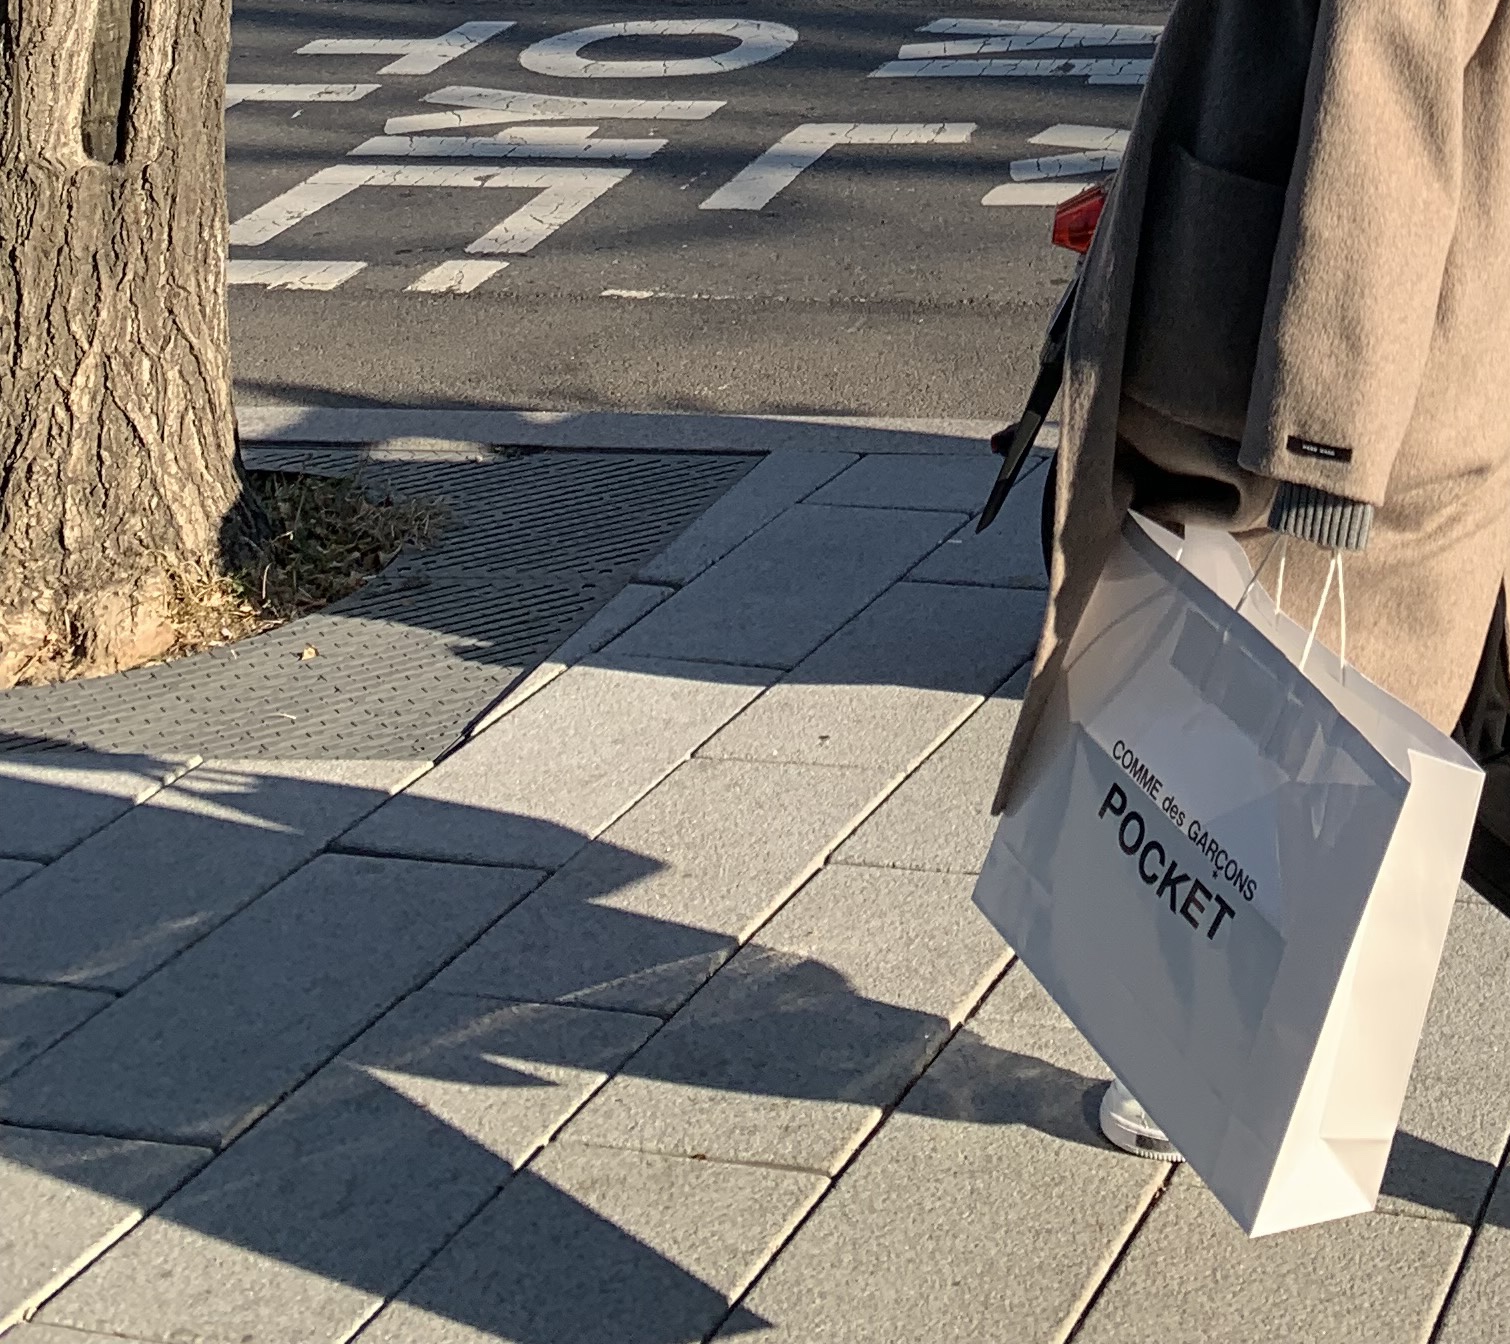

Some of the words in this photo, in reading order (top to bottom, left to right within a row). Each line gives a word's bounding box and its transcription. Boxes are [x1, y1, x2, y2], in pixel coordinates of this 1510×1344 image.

[1112, 739, 1163, 801] COMME
[1162, 795, 1186, 827] des
[1097, 781, 1236, 941] POCKET
